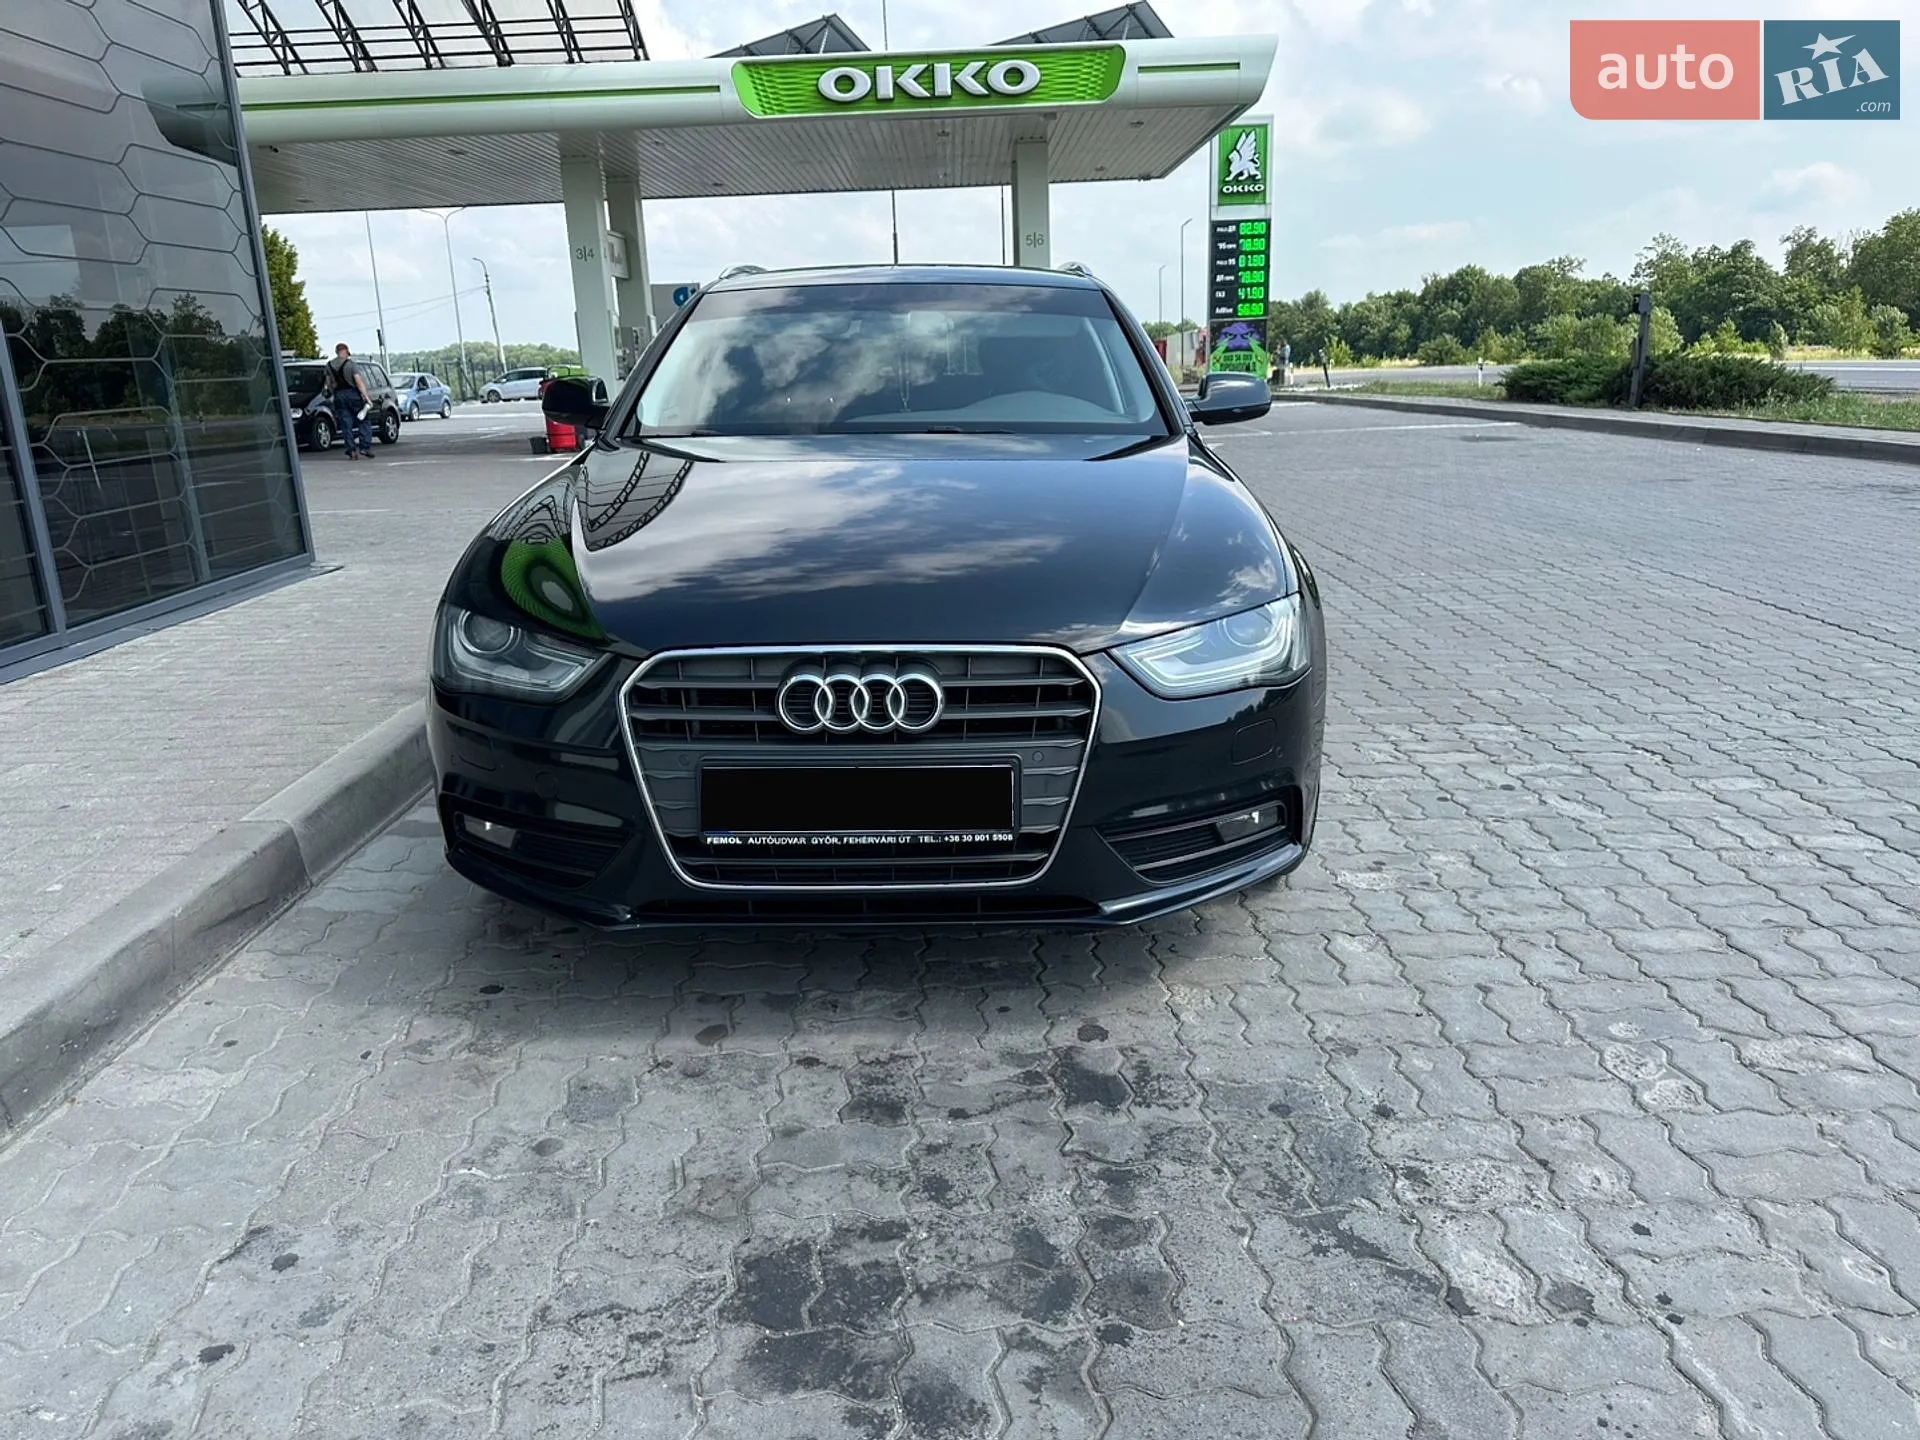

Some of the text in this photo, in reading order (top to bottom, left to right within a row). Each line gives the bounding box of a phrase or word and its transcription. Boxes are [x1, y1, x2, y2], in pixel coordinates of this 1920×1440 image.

[817, 59, 1042, 102] OKKO
[1222, 184, 1265, 193] OKKO
[706, 836, 742, 845] FEMOL
